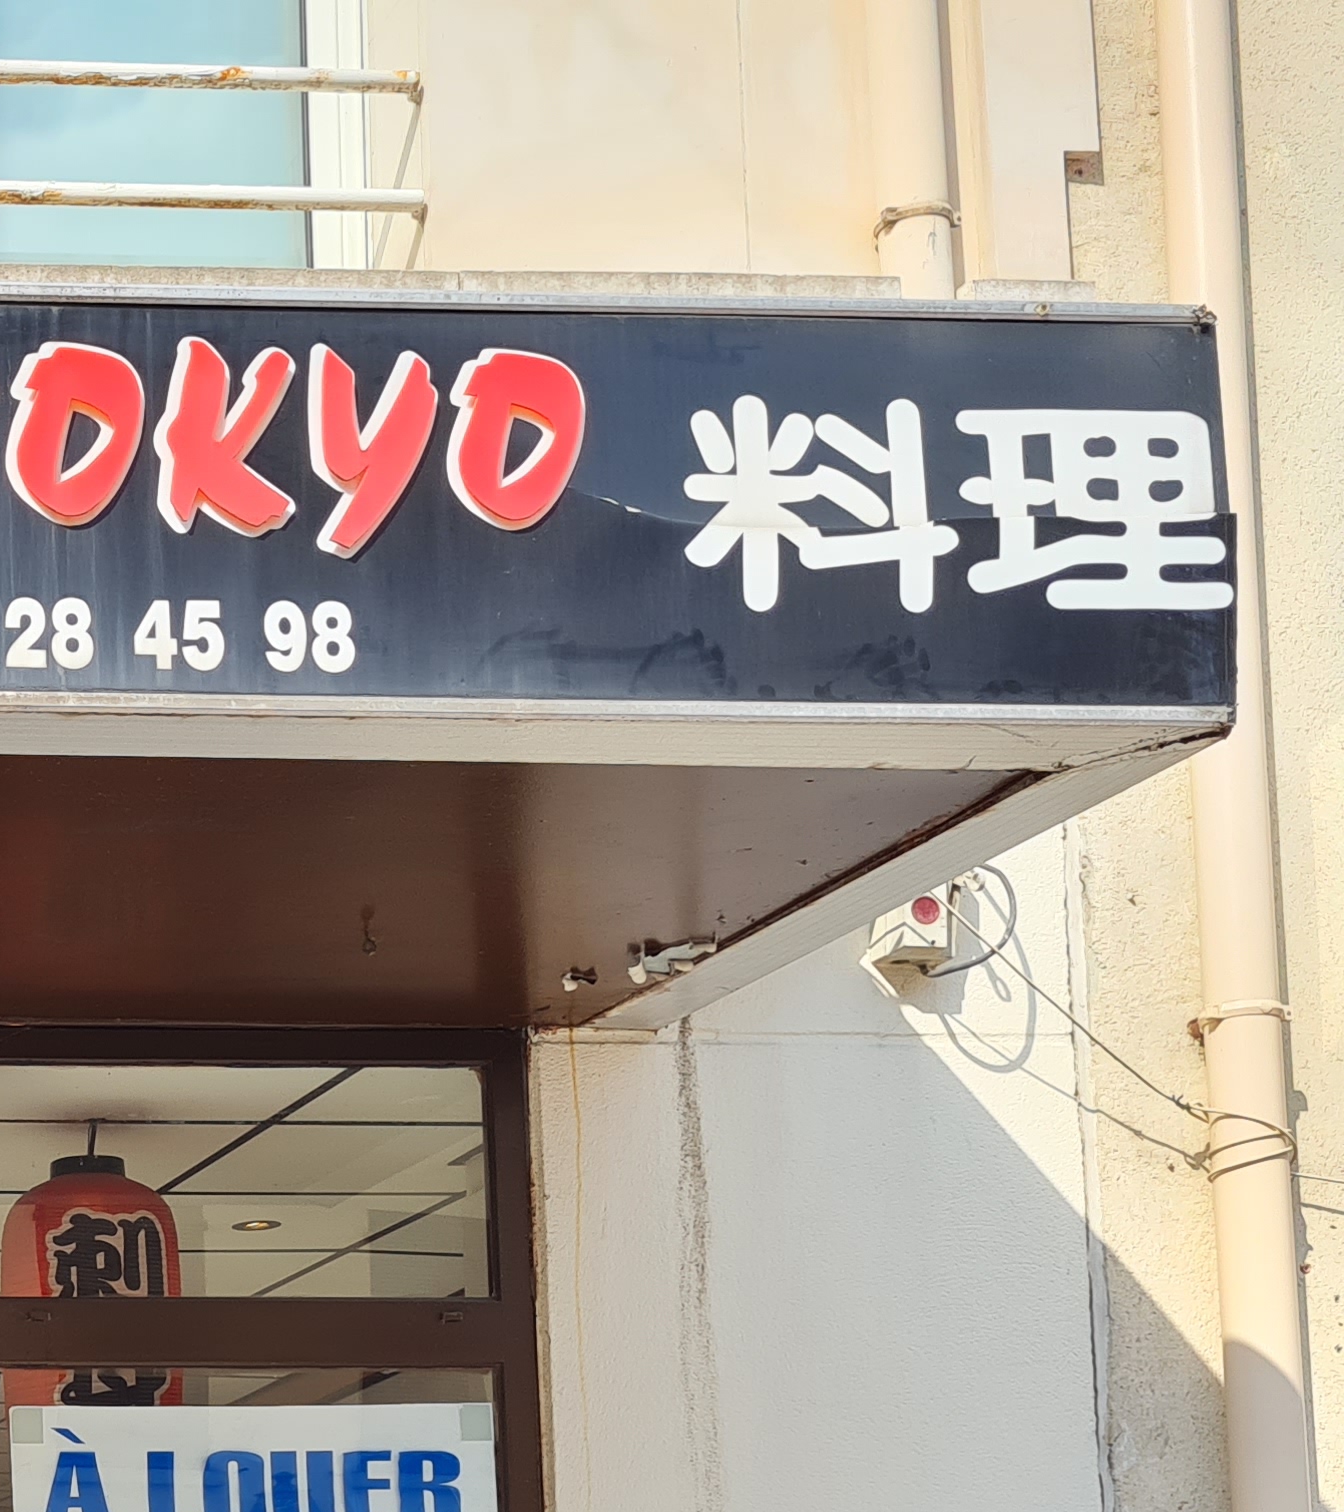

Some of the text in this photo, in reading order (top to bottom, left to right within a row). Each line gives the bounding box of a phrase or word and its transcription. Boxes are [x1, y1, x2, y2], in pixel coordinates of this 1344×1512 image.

[683, 394, 1235, 613] 料理
[4, 596, 96, 670] 28
[133, 598, 226, 672] 45
[263, 600, 357, 673] 98
